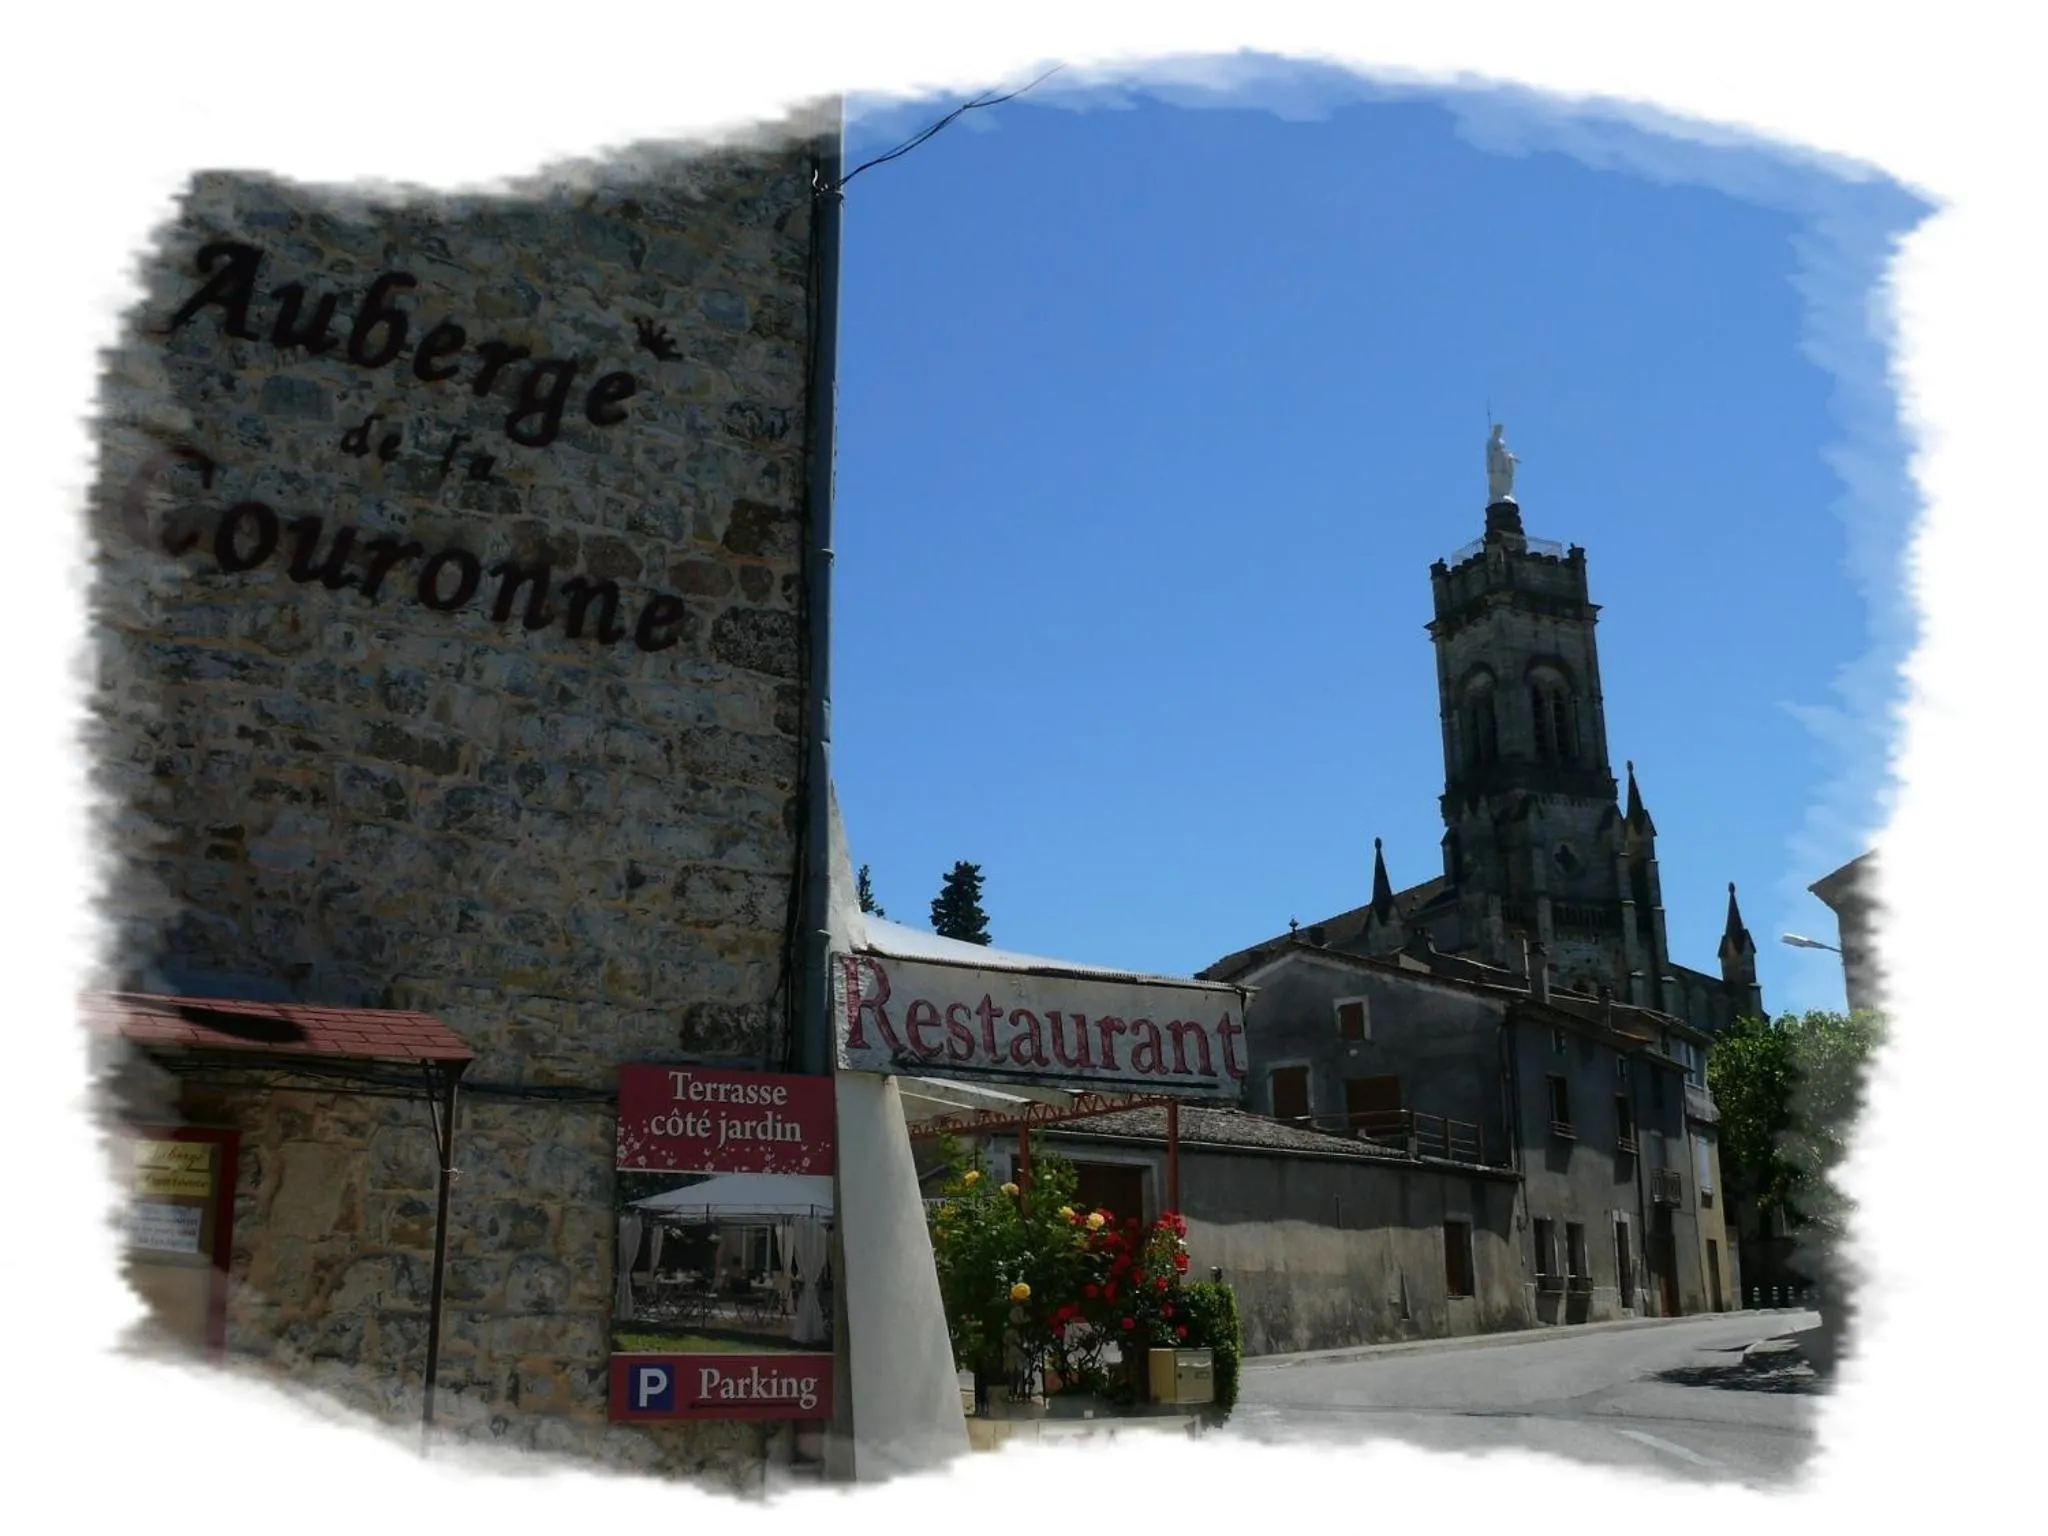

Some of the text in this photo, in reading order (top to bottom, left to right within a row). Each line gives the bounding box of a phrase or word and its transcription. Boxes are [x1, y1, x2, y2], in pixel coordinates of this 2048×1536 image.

[167, 242, 637, 447] Auberge
[340, 415, 497, 480] de la
[128, 445, 685, 652] Couronne
[840, 955, 1249, 1079] Restaurant
[668, 1071, 787, 1105] Terrasse
[650, 1108, 801, 1149] côté jardin
[638, 1366, 818, 1410] P Parking
